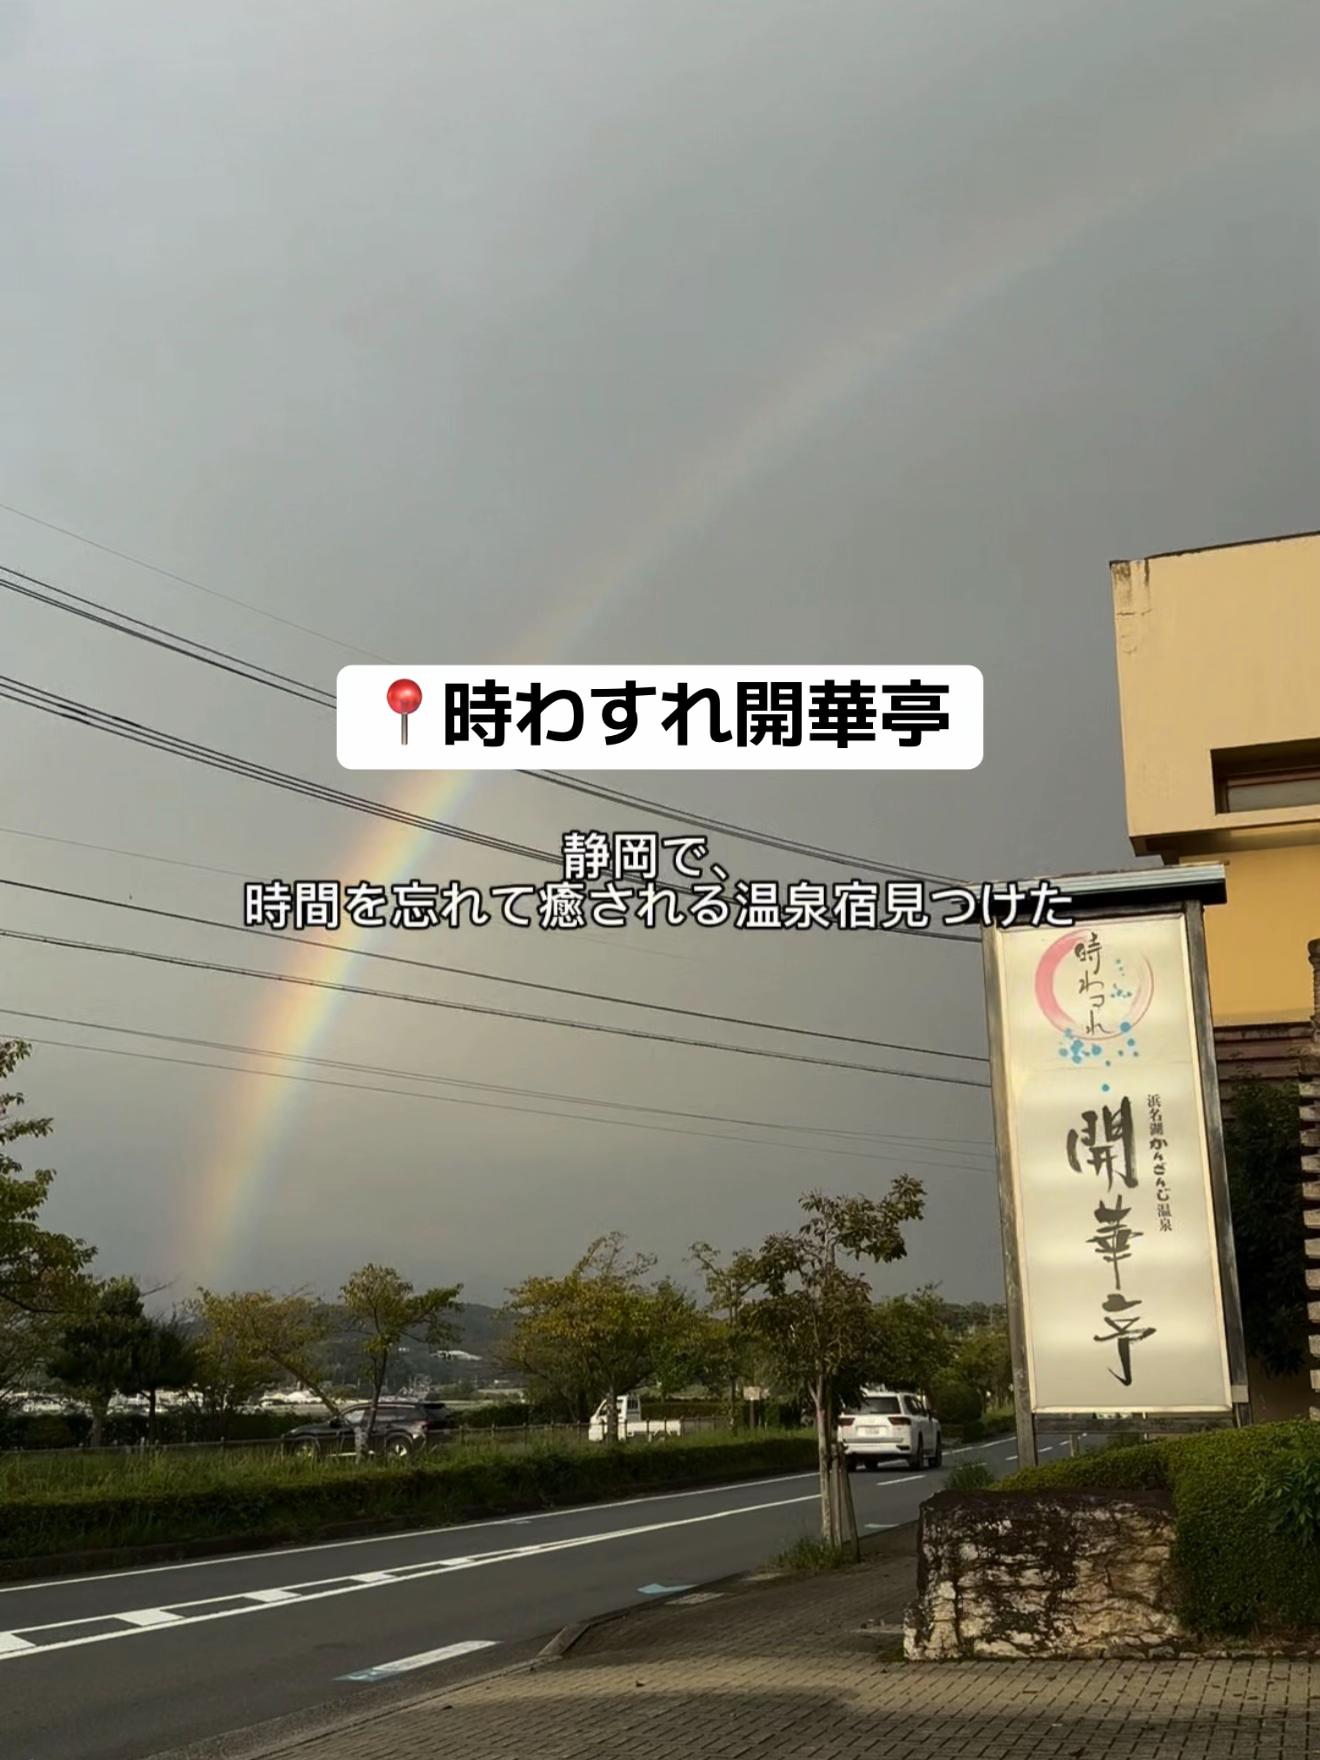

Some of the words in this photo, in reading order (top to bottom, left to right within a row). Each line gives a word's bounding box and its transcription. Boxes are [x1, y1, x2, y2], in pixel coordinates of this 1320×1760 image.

[1066, 1096, 1157, 1387] 開華亭
[1147, 1093, 1172, 1232] 浜名湖かんざんじ温泉
